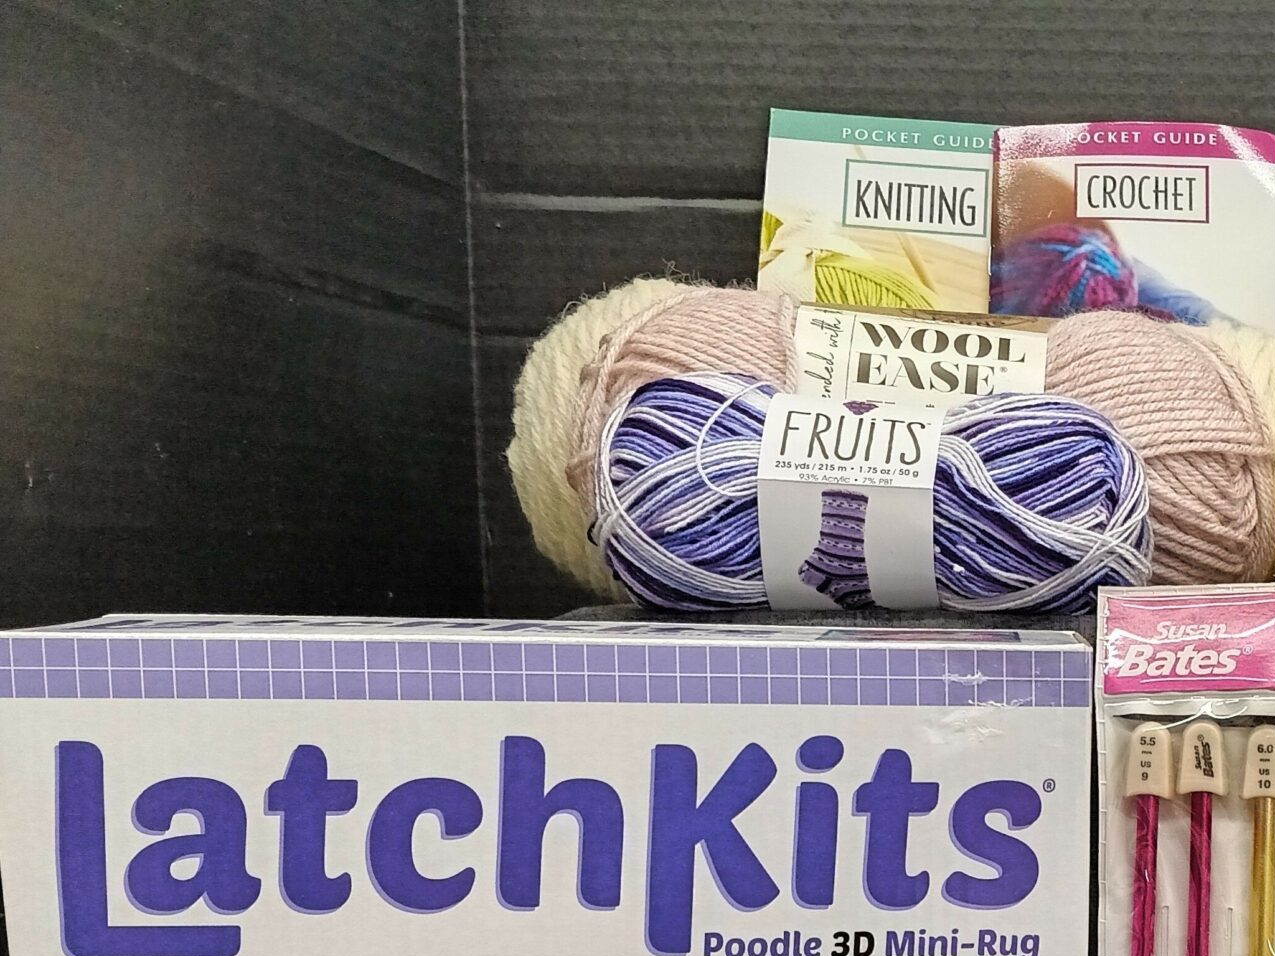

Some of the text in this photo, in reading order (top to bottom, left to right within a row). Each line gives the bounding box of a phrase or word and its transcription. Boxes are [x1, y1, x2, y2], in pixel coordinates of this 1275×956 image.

[842, 127, 921, 144] POCKET
[1153, 132, 1217, 146] GUIDE
[1087, 175, 1196, 211] CROCHET
[855, 179, 977, 227] KNITTING
[810, 317, 844, 348] with
[860, 321, 1026, 363] WOOL
[852, 352, 995, 397] EASE
[775, 460, 792, 469] 235
[794, 462, 810, 471] yds
[818, 463, 835, 472] 215
[859, 466, 878, 474] 1.75
[1154, 620, 1227, 640] Susan
[1117, 644, 1243, 677] Bates
[1140, 736, 1156, 746] 5.5
[1257, 744, 1274, 754] 6.0
[1201, 741, 1214, 778] Bates
[1141, 772, 1149, 781] 9
[1259, 768, 1270, 776] US
[1258, 779, 1271, 789] 10
